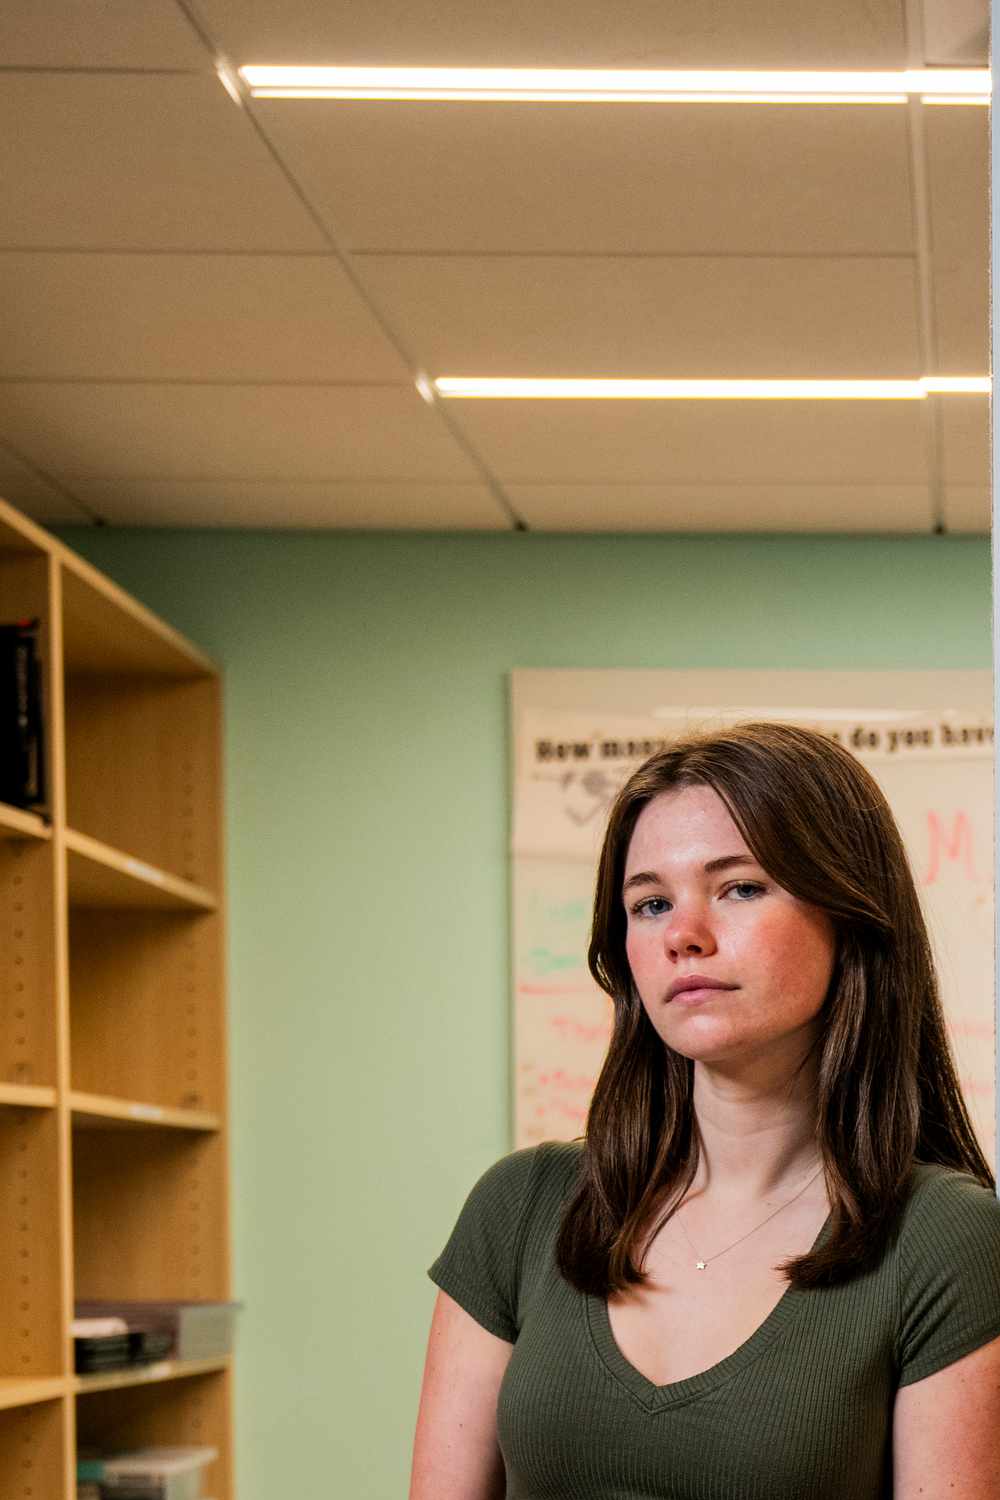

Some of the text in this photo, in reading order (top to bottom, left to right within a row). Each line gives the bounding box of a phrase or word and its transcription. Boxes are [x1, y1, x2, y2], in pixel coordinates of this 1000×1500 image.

[536, 739, 592, 761] How
[851, 725, 879, 749] do
[887, 729, 933, 753] you
[940, 721, 995, 746] hav
